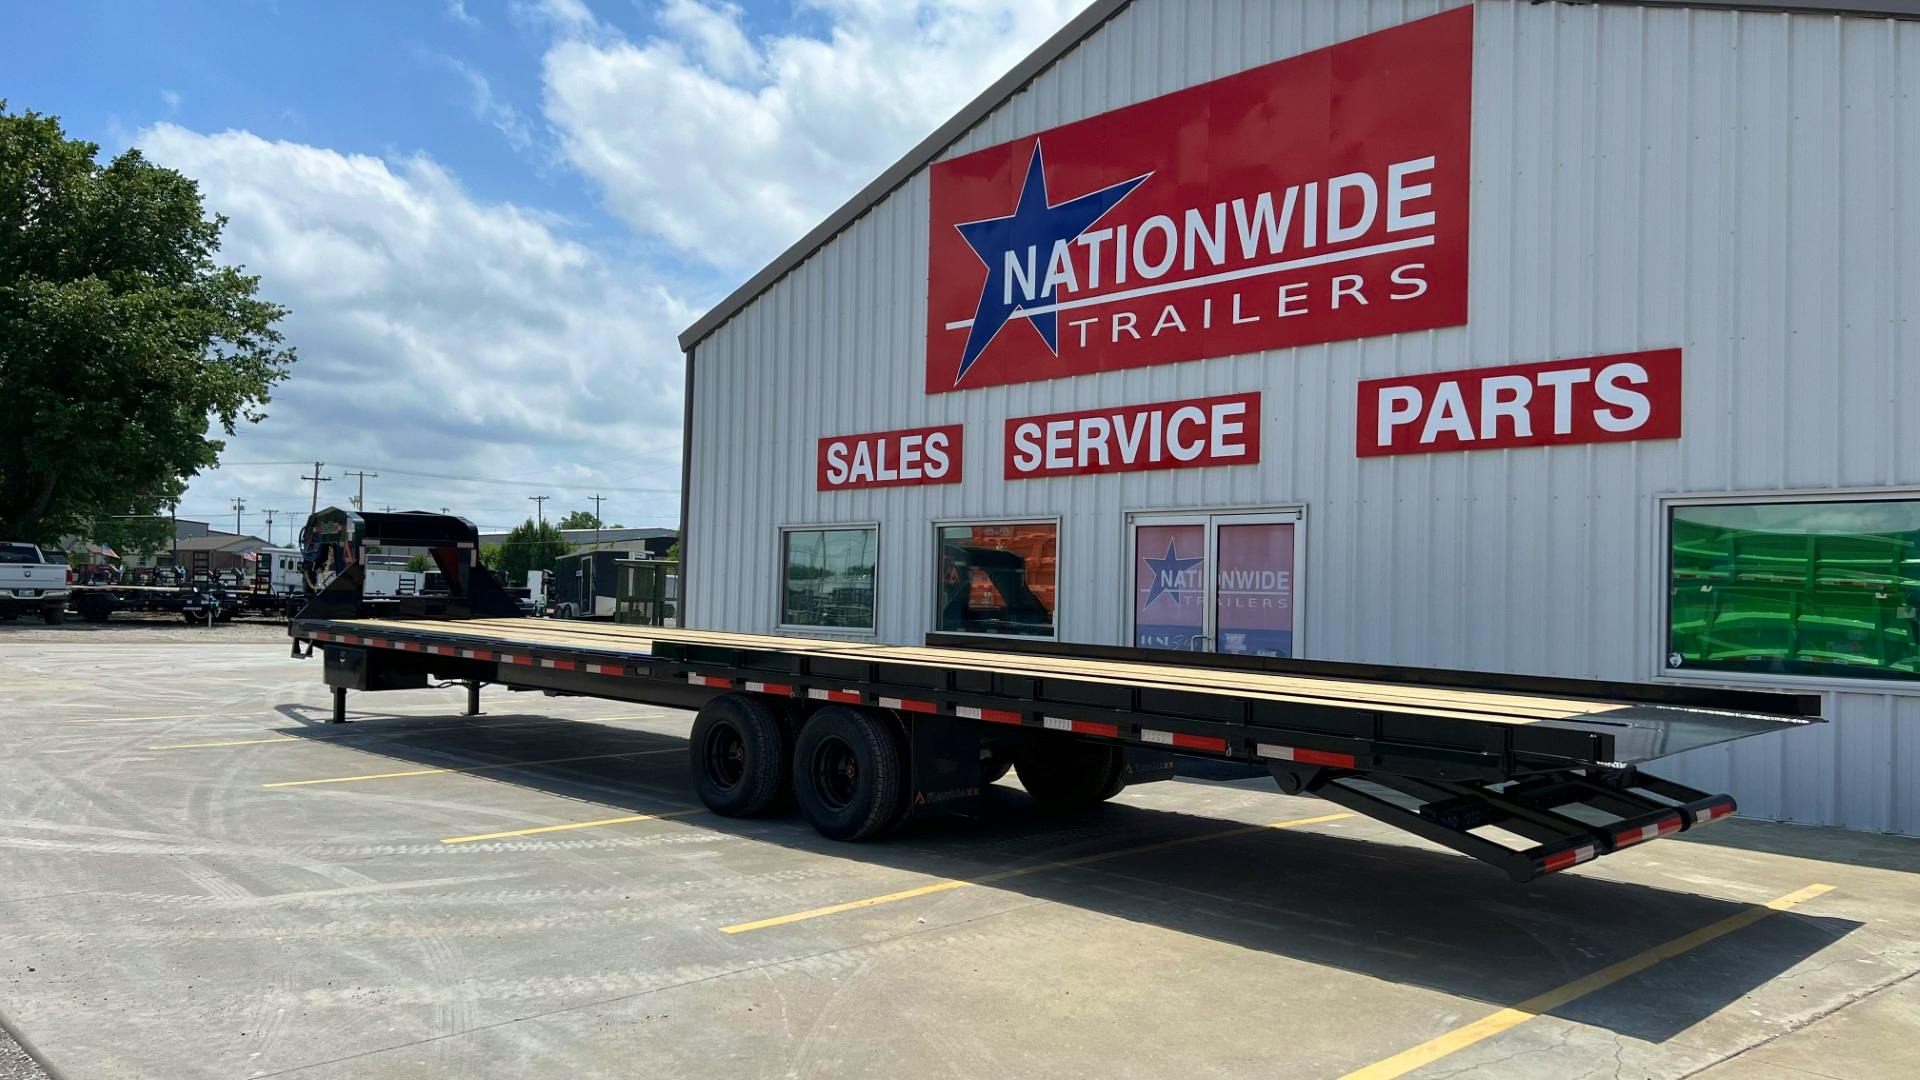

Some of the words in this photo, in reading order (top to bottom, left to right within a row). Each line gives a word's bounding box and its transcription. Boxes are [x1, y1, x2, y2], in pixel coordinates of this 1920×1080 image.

[1003, 155, 1436, 305] NATIONWIDE
[1068, 263, 1429, 349] TRAILERS
[1013, 402, 1247, 472] SERVICE
[1377, 362, 1651, 447] PARTS
[826, 432, 950, 485] SALES
[1160, 569, 1290, 590] NATINWIDE
